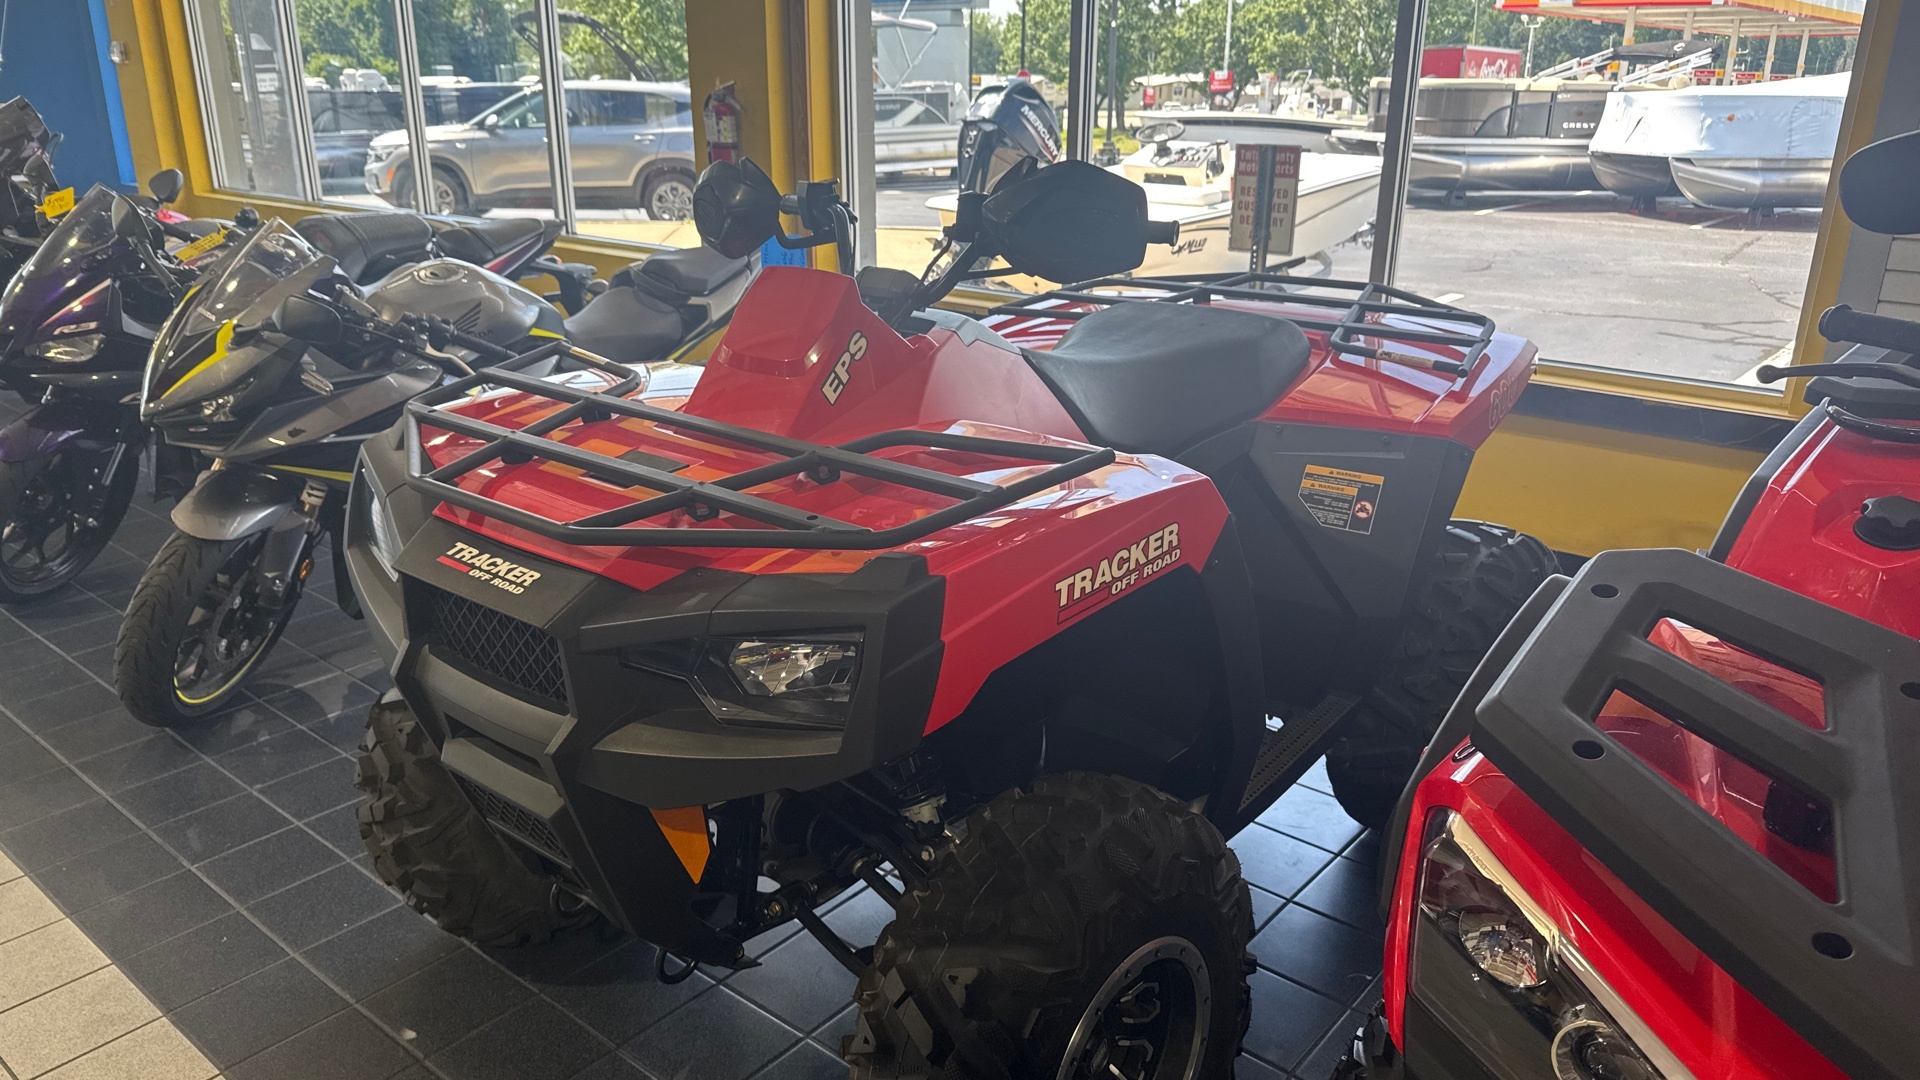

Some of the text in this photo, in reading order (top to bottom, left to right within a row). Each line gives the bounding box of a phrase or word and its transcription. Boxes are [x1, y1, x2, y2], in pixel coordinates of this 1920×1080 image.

[1020, 105, 1059, 156] MERCURY
[1239, 162, 1294, 174] Motorts
[1240, 187, 1288, 199] RESED
[1238, 201, 1288, 213] CUSMER
[1240, 215, 1284, 227] DERY
[821, 331, 868, 405] EPS
[1336, 471, 1361, 479] WARNING
[1318, 484, 1344, 492] WARNING
[446, 541, 541, 587] TRACKER
[1055, 522, 1179, 607] TRACKER
[1111, 548, 1181, 595] OFF ROAD
[468, 569, 525, 595] OFF ROAD
